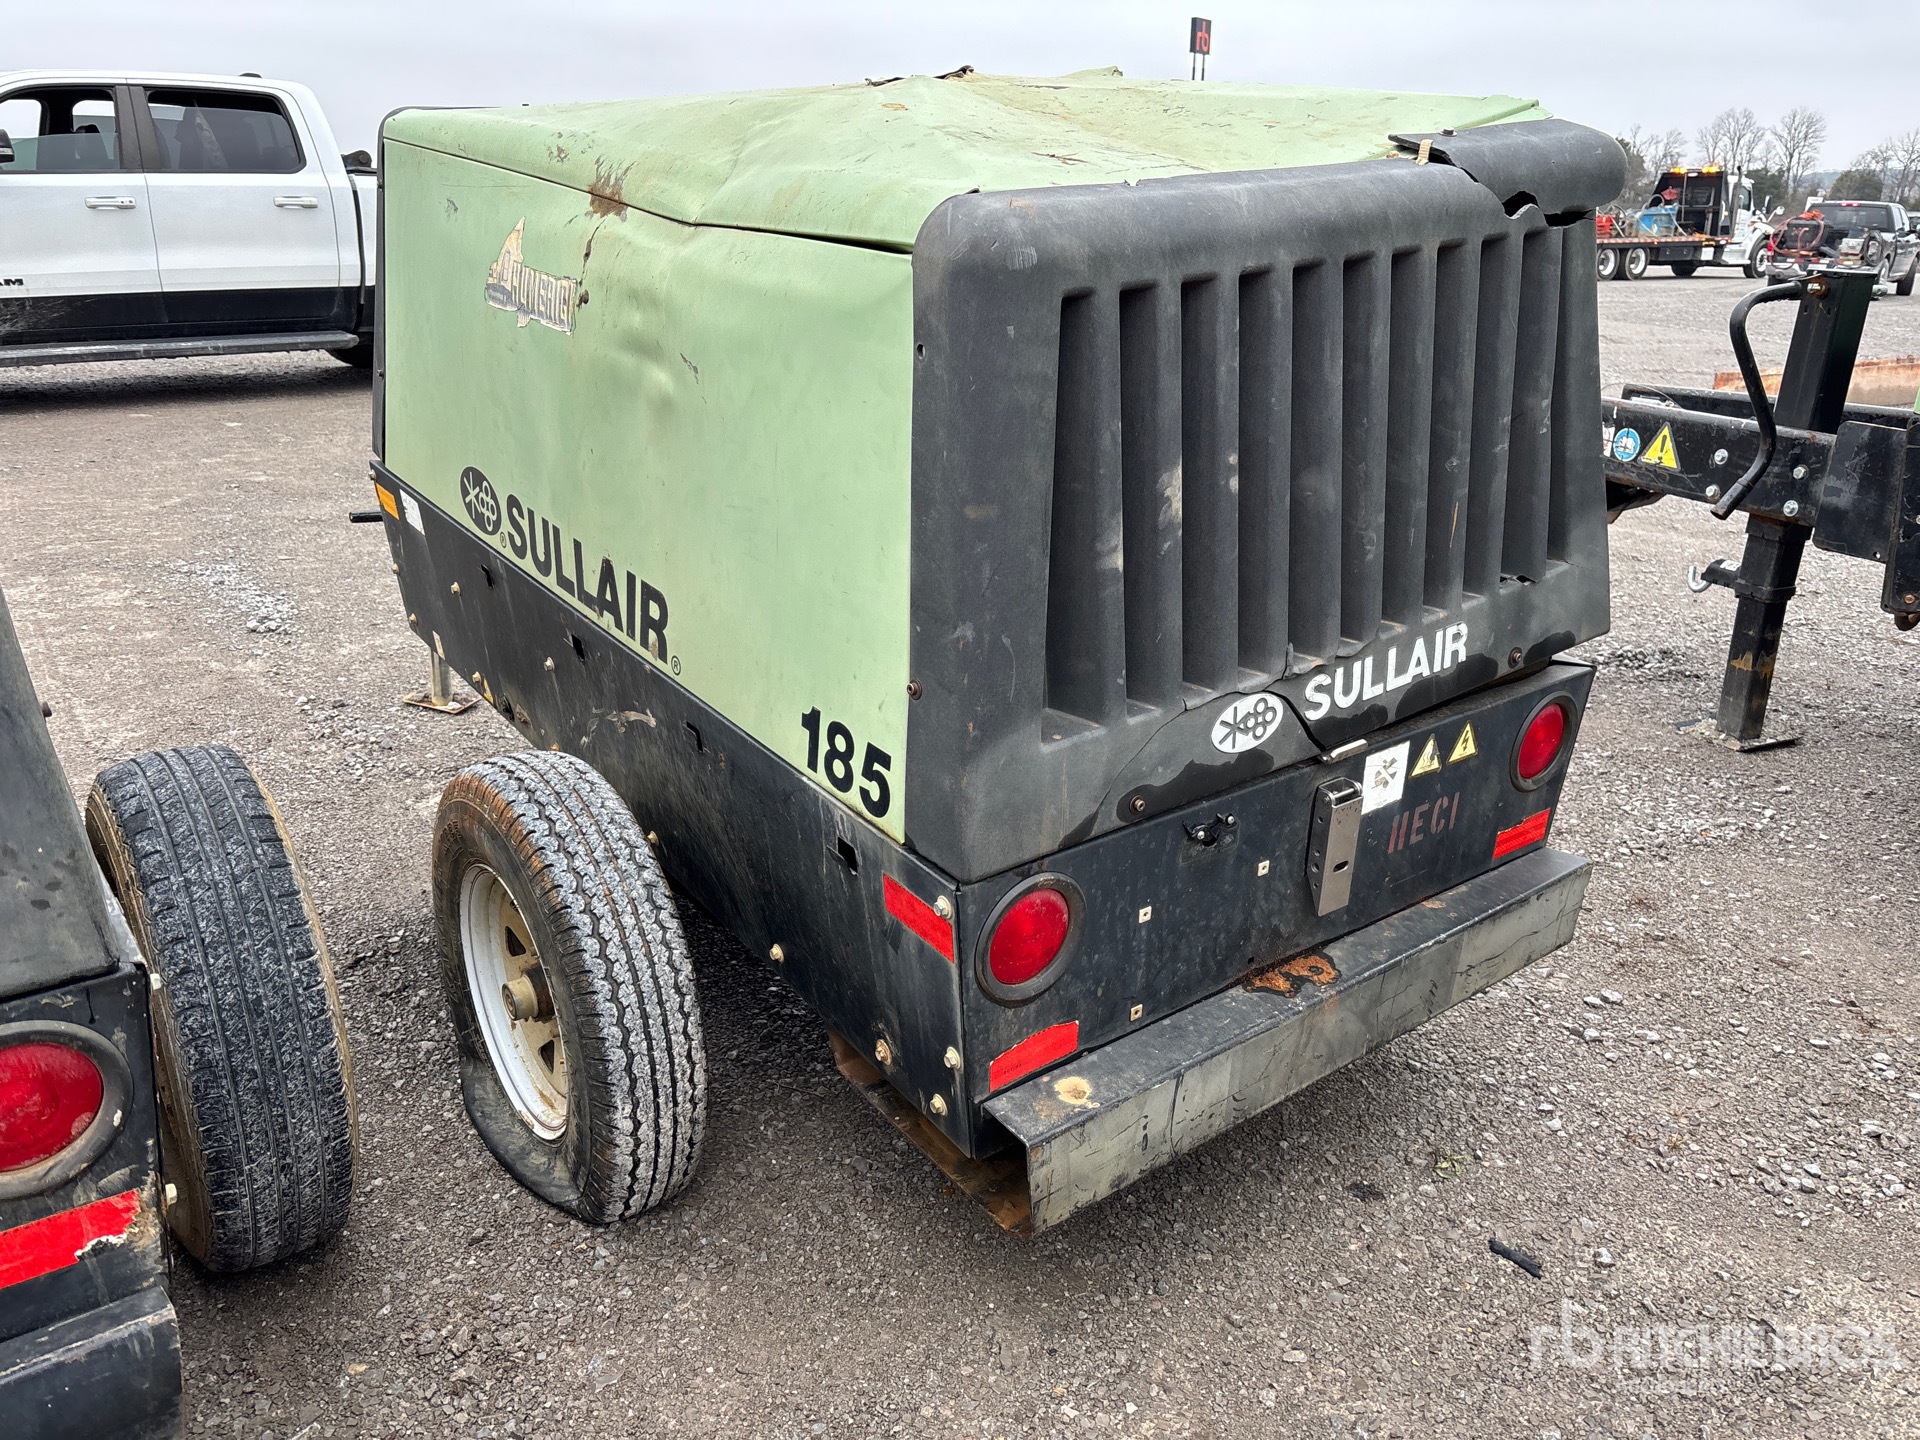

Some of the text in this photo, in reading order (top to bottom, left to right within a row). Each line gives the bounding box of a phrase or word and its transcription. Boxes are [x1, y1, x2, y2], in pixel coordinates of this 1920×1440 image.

[506, 494, 669, 664] SULLAIR
[1304, 622, 1469, 721] SULLAIR
[801, 706, 891, 818] 185
